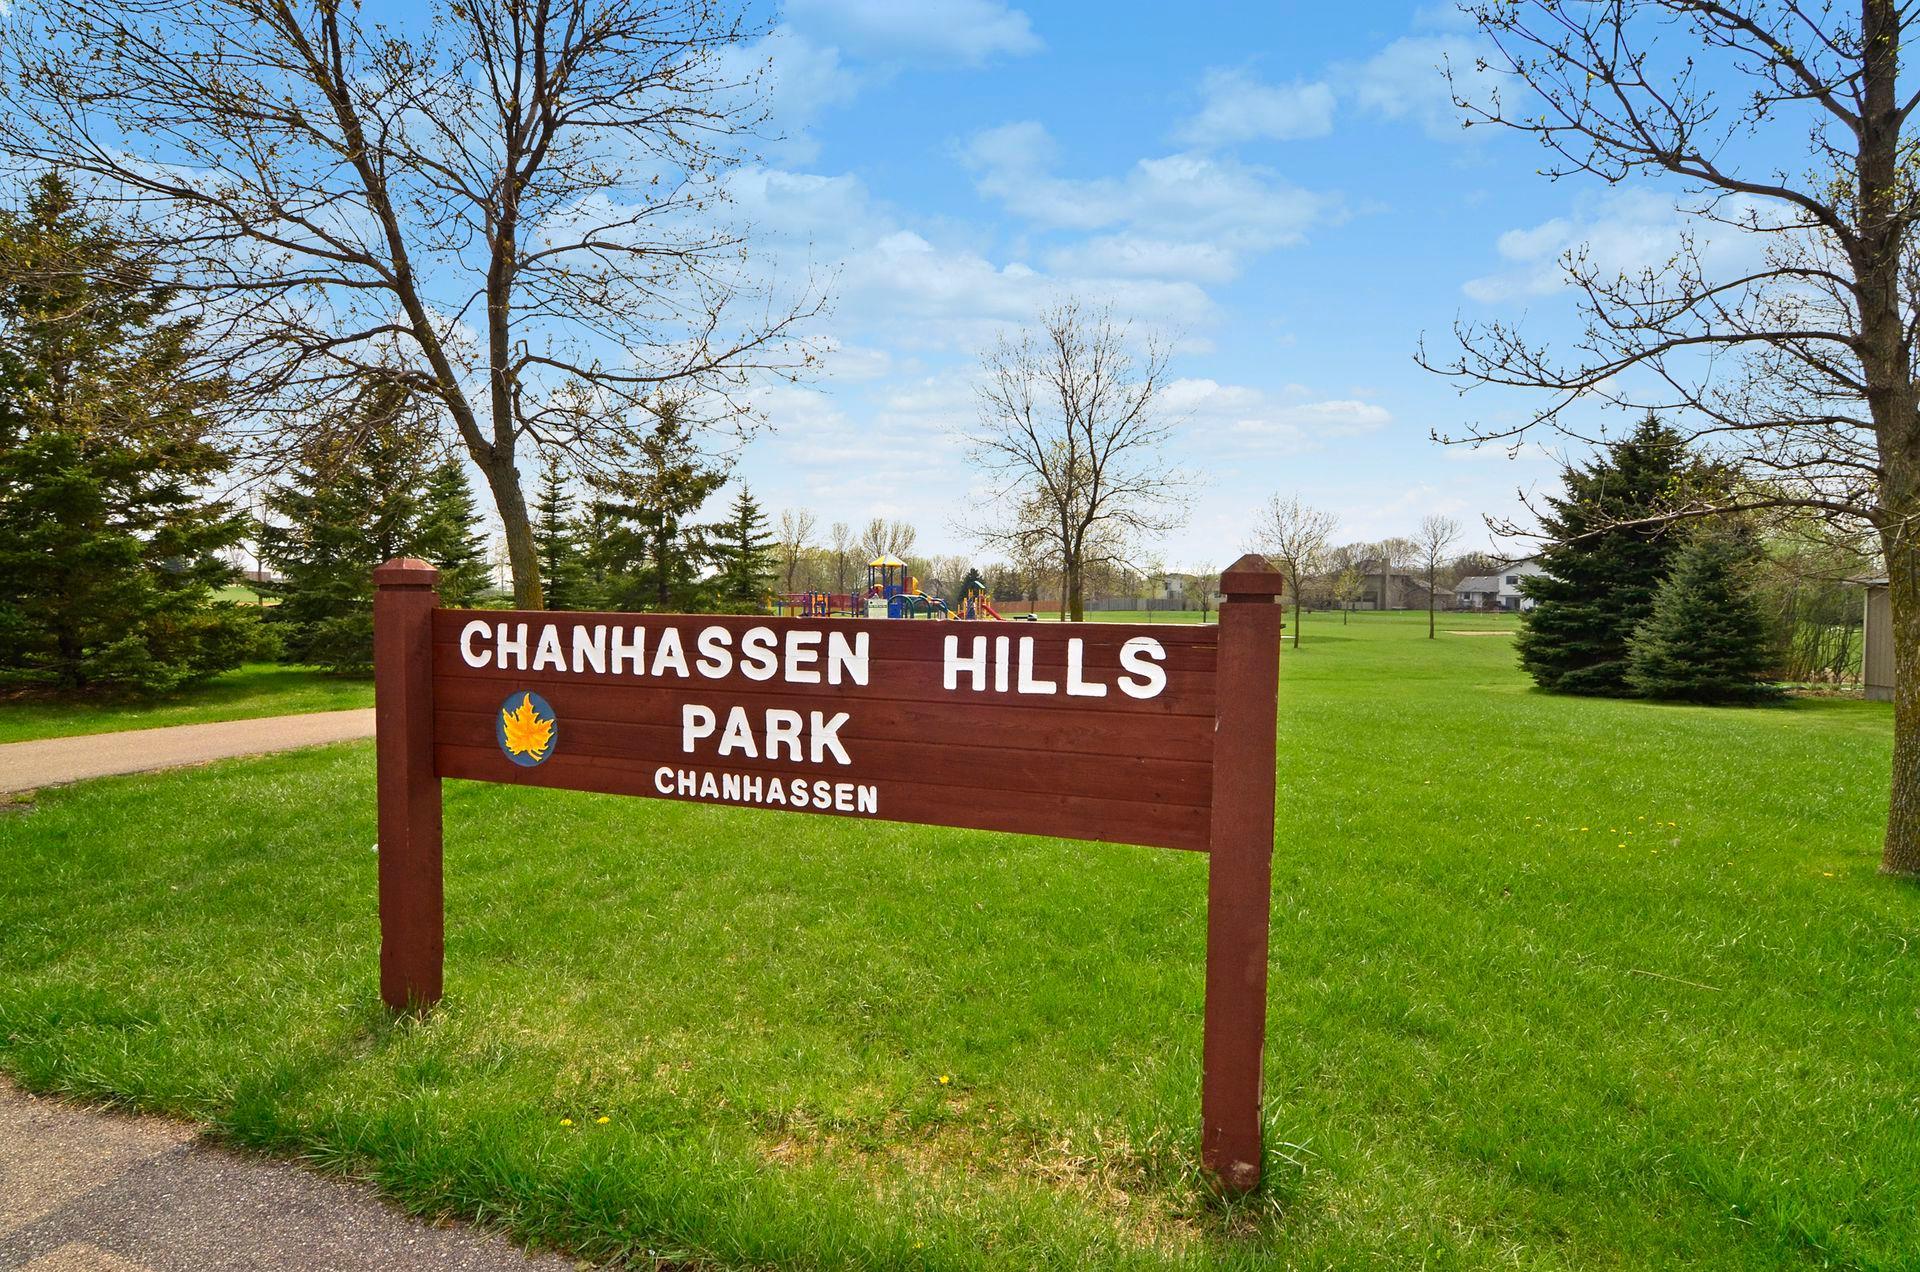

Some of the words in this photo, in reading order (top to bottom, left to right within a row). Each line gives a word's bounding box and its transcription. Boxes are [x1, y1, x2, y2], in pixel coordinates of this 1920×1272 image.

[459, 619, 870, 686] CHANHASSEN
[943, 635, 1167, 700] HILLS
[681, 703, 852, 765] PARK
[654, 766, 878, 814] CHANHASSEN
